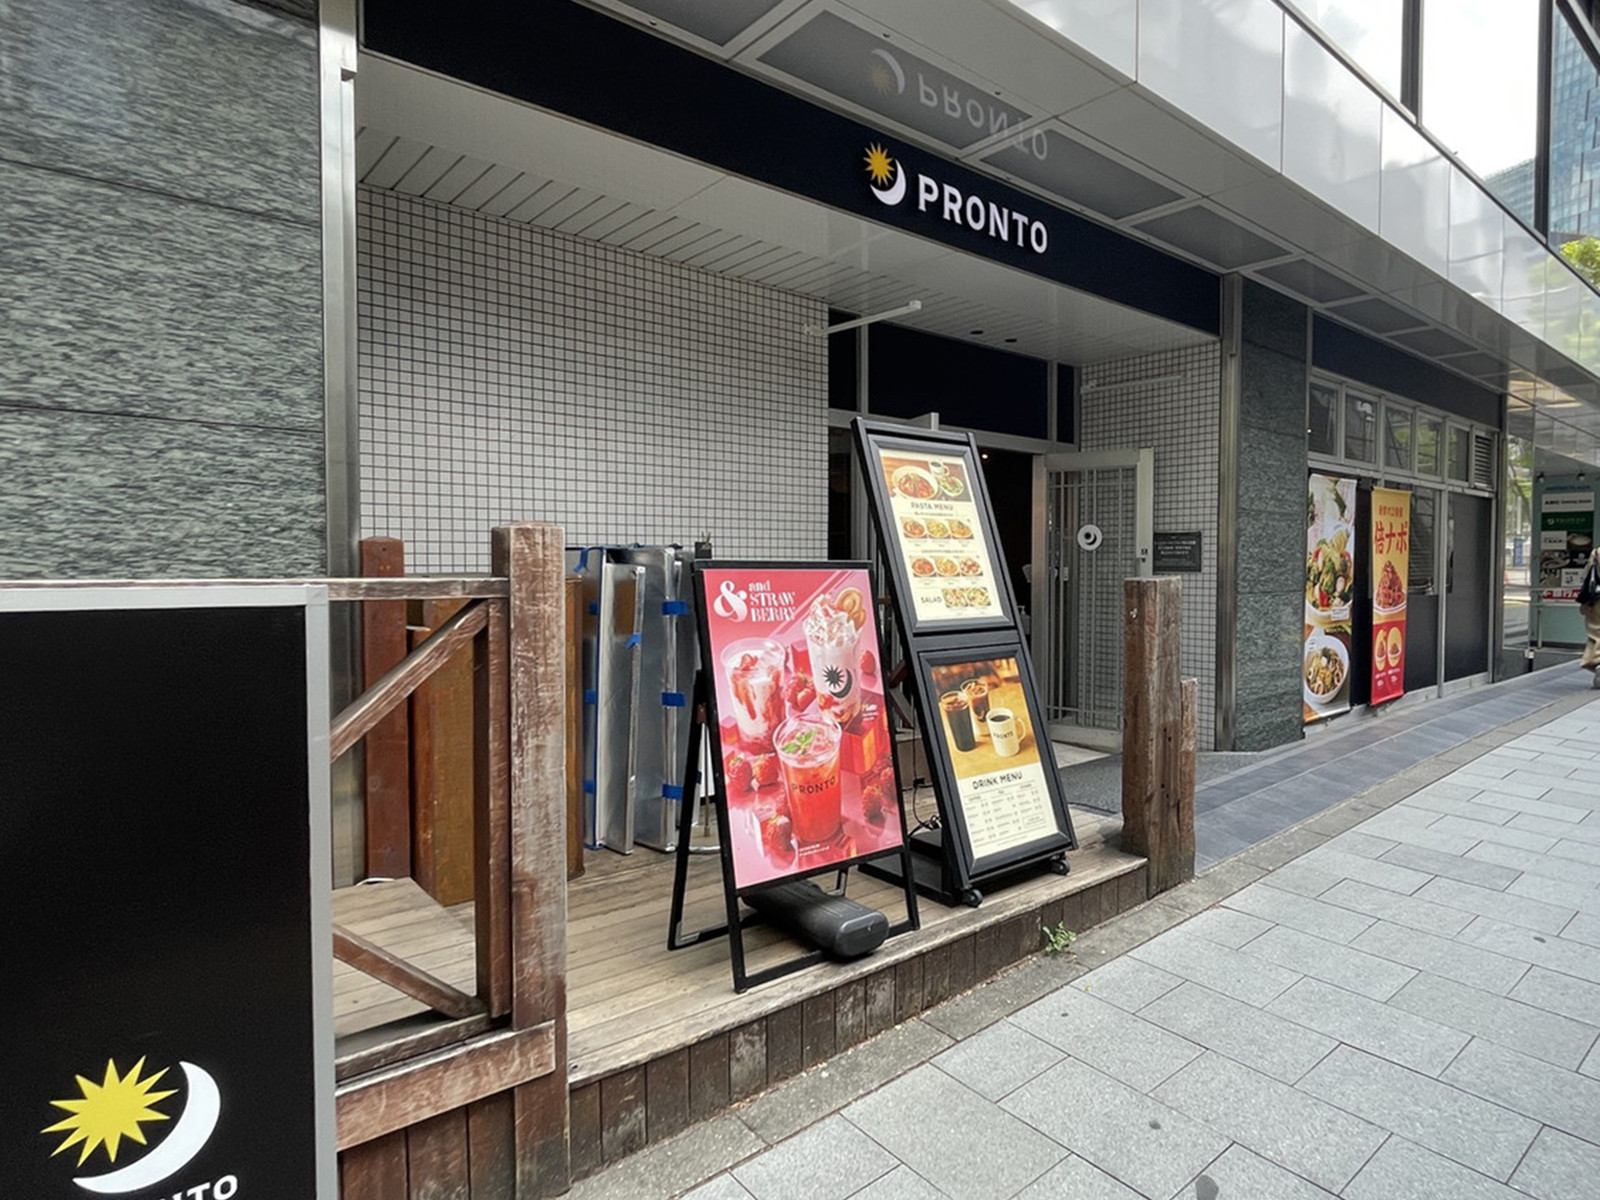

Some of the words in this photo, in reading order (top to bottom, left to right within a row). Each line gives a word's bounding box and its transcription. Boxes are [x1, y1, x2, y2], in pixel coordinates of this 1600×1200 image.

[917, 173, 1048, 254] PRONTO
[911, 501, 933, 510] PASTA
[933, 503, 954, 511] MENU
[748, 580, 770, 592] and
[713, 580, 748, 623] &
[749, 592, 796, 607] STRAW
[750, 606, 796, 622] BERRY
[791, 775, 836, 794] PRONTO
[972, 777, 999, 790] DRINK
[999, 771, 1023, 784] MENU
